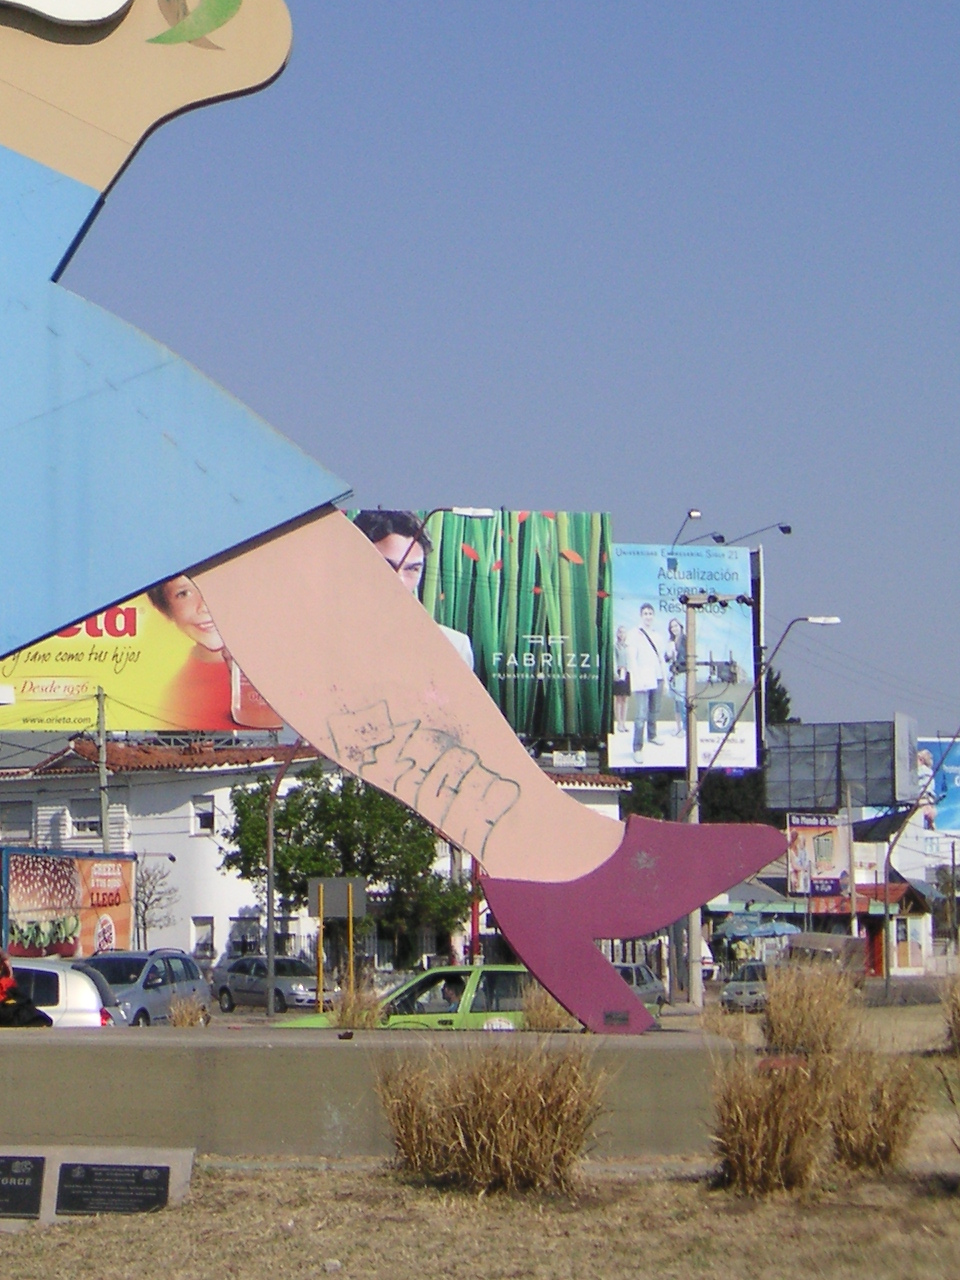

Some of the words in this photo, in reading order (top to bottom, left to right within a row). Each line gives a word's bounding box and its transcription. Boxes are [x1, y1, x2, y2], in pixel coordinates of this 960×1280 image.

[657, 567, 739, 581] Actualización
[23, 649, 52, 664] sano
[54, 651, 86, 663] como
[88, 644, 108, 663] tus
[111, 645, 142, 675] hijos
[492, 652, 600, 668] FABRIZZI
[21, 680, 61, 695] Desde
[63, 681, 90, 698] 1956
[90, 890, 122, 908] LLEGÓ
